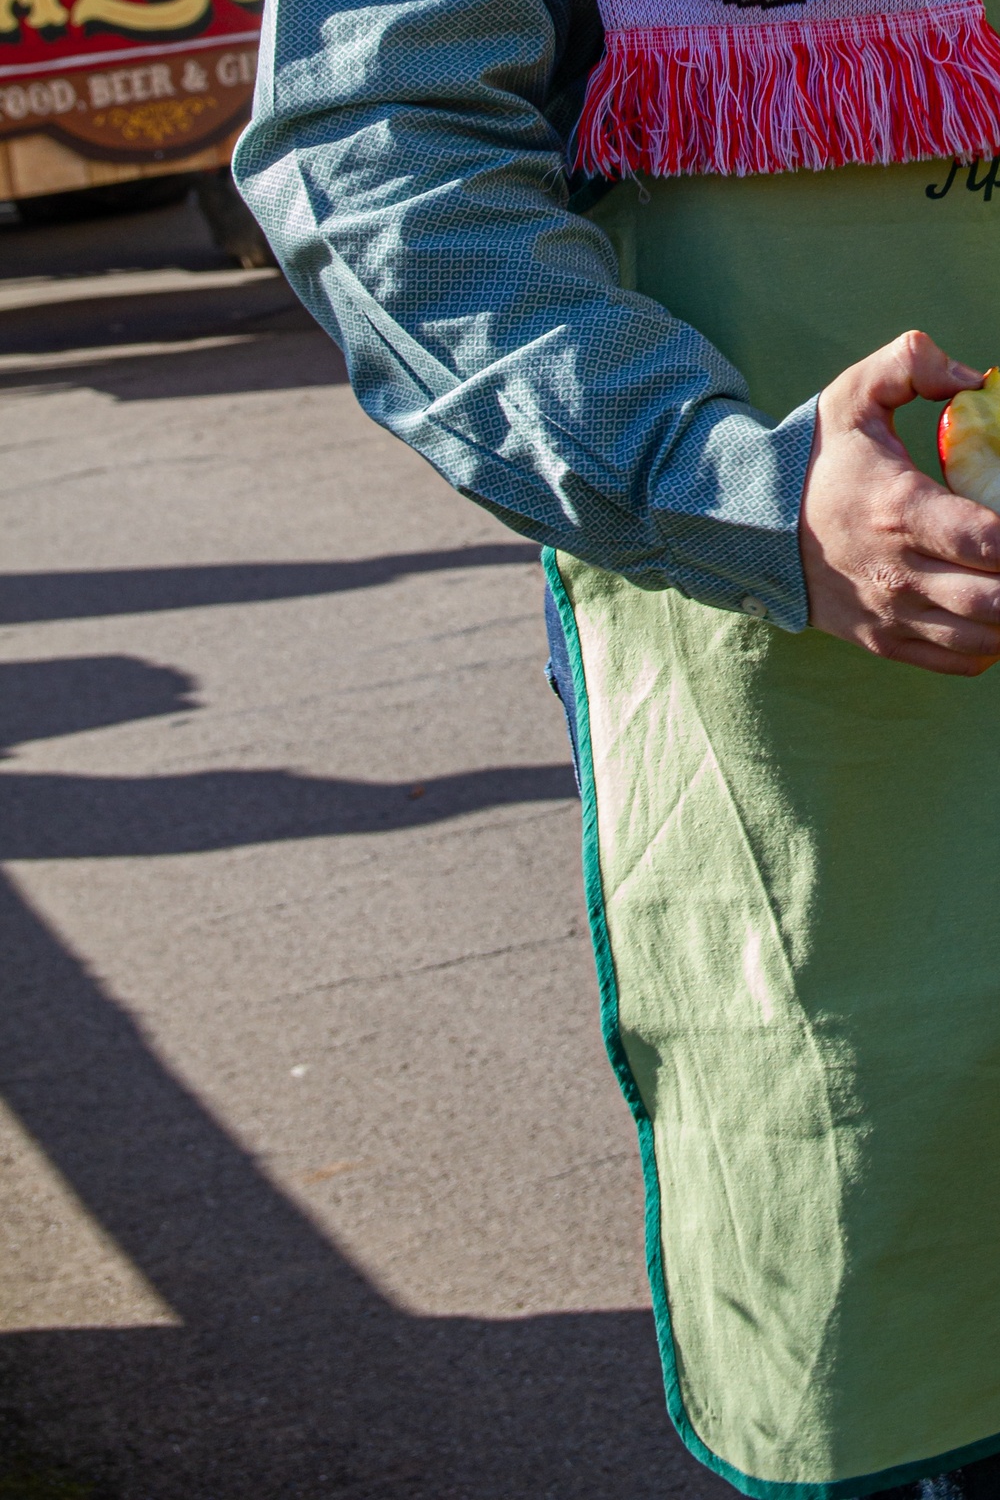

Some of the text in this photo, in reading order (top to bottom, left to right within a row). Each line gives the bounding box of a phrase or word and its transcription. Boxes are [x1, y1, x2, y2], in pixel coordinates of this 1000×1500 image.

[0, 51, 259, 120] OOD, BEER & GI
